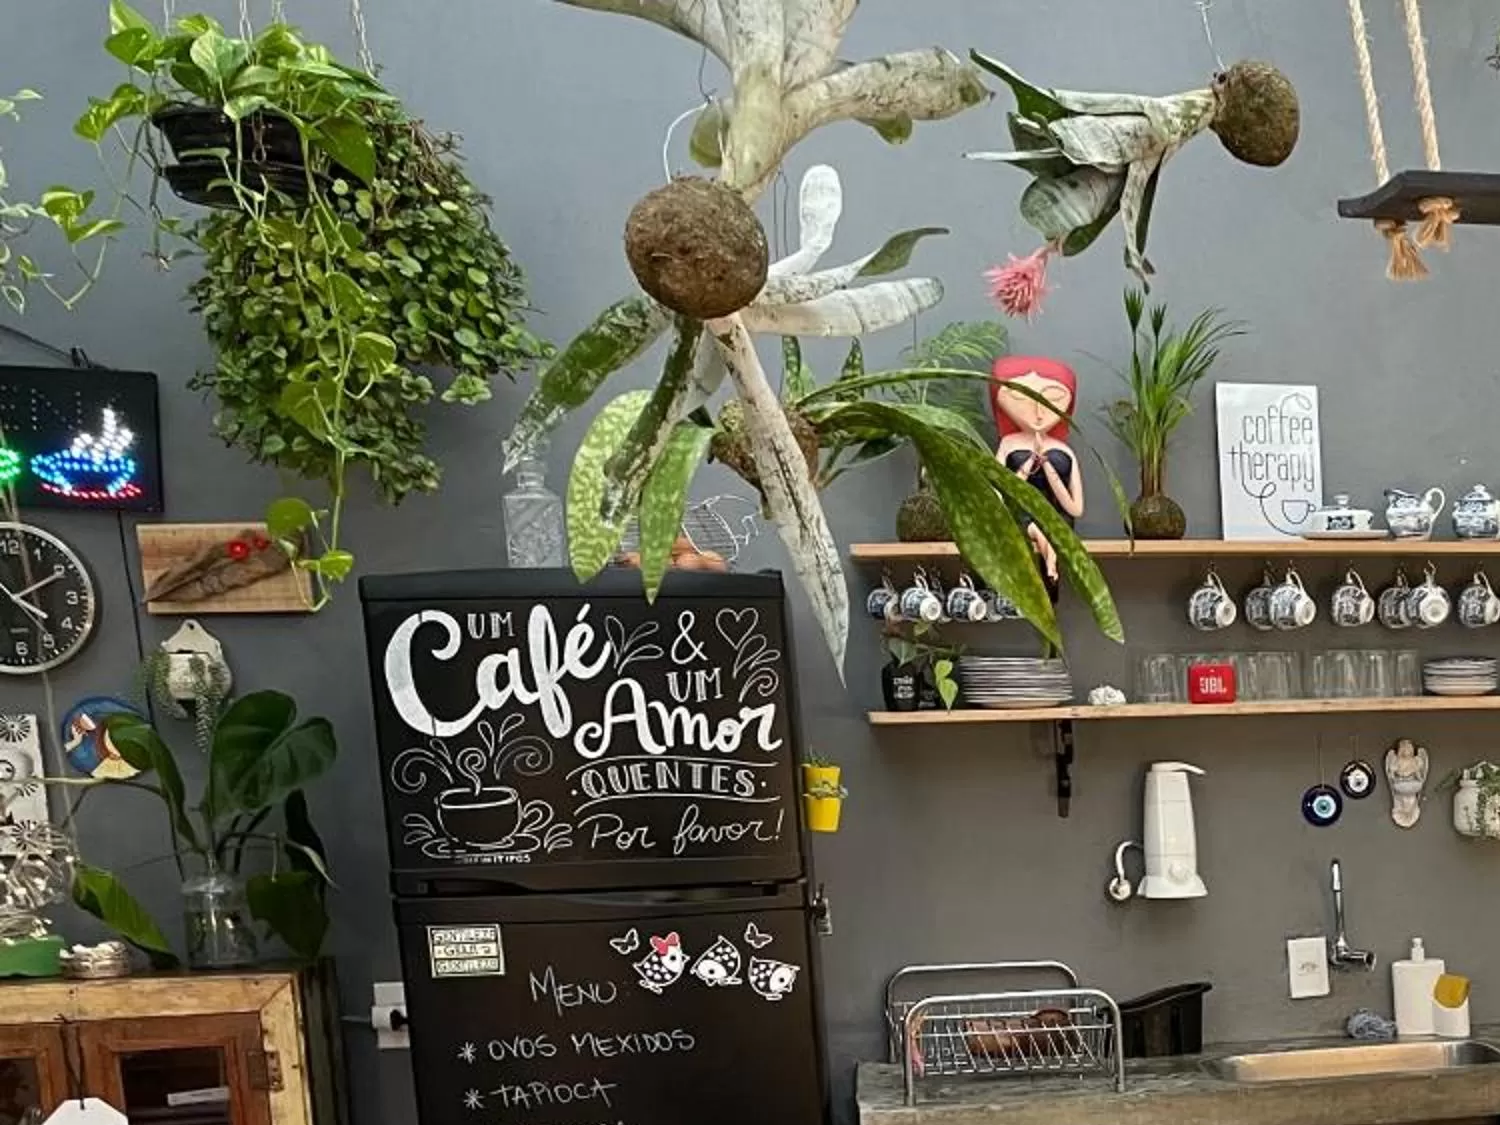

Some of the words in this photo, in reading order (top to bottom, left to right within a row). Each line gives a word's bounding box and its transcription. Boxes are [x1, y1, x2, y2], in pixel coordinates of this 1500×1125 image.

[1242, 392, 1313, 445] coffee
[1226, 441, 1315, 493] therapy
[65, 591, 79, 605] 3
[61, 616, 73, 630] 4
[467, 611, 514, 640] UM
[670, 610, 708, 665] &
[15, 641, 29, 656] 6
[384, 603, 614, 739] Café
[666, 667, 724, 702] UM
[1200, 676, 1227, 695] JBL
[573, 677, 784, 758] Amor
[581, 761, 757, 798] QUENTES
[578, 812, 657, 849] Por
[673, 803, 786, 856] favor!
[488, 1033, 557, 1061] OVOS
[571, 1028, 696, 1060] MEXIDOS
